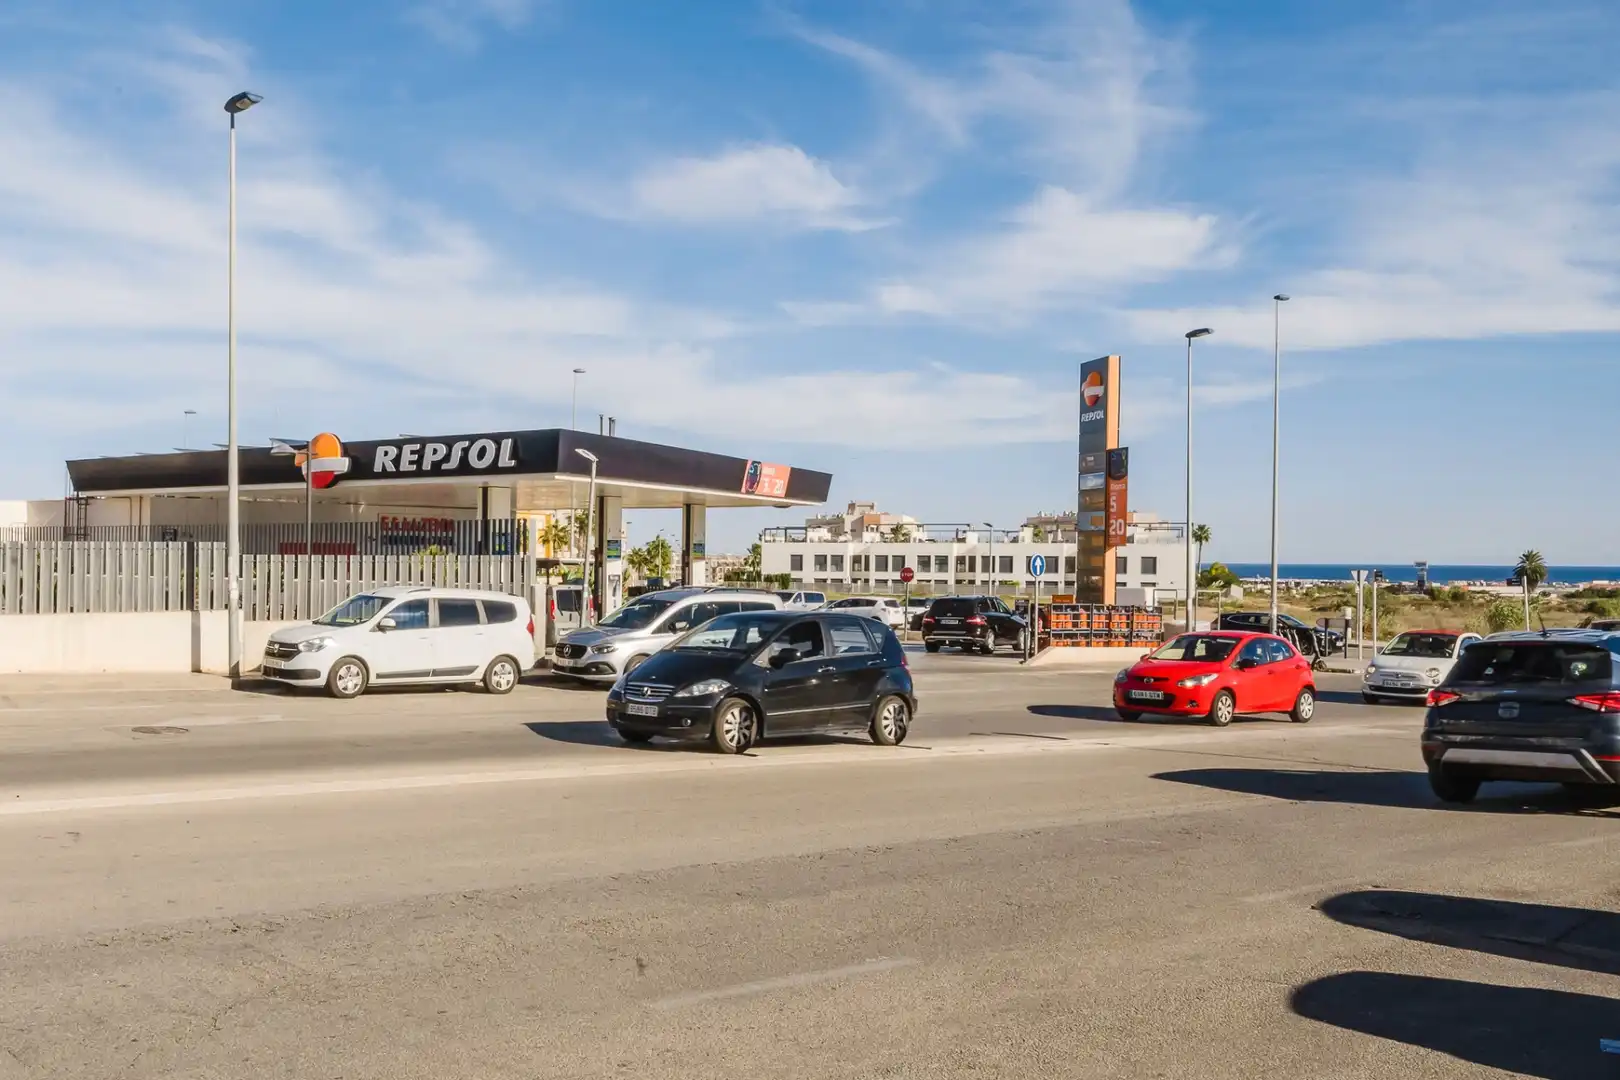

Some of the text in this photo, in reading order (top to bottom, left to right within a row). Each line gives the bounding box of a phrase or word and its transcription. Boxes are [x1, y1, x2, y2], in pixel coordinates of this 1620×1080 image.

[1081, 410, 1105, 422] REPSOL
[374, 438, 517, 472] REPSOL
[1110, 495, 1117, 512] 5
[1110, 519, 1125, 536] 20
